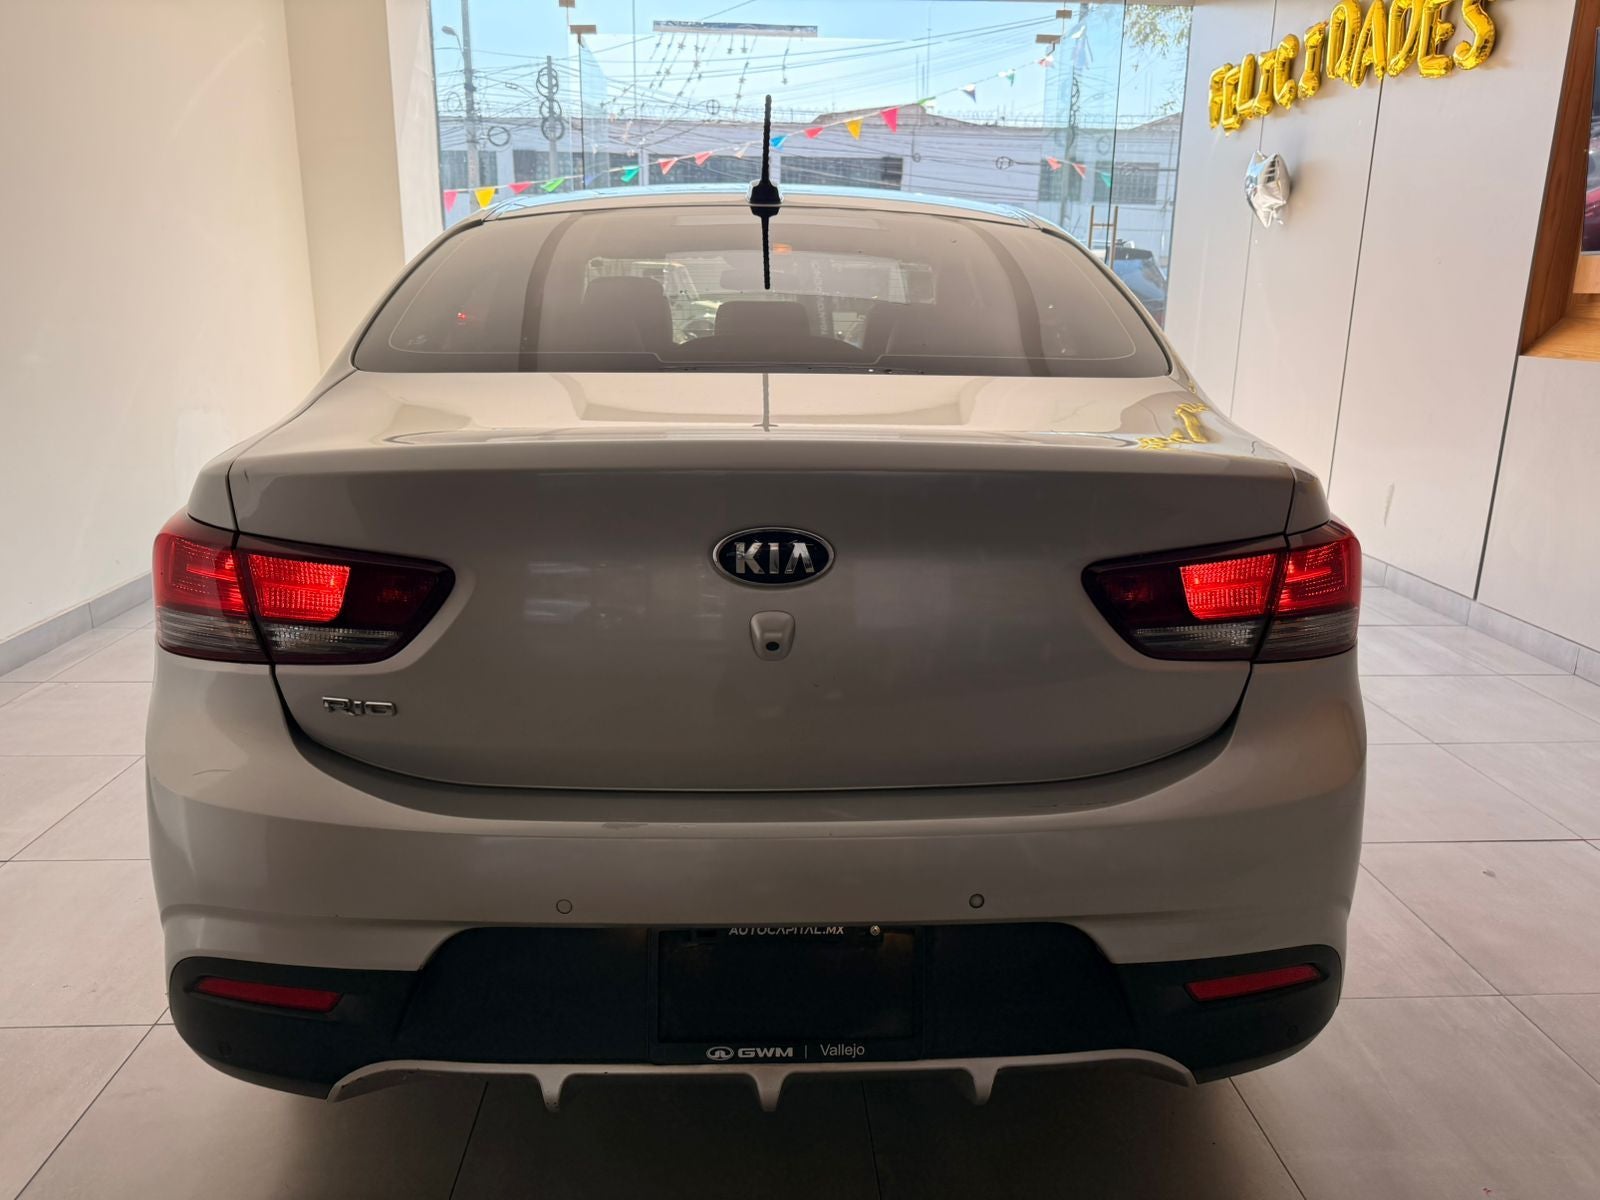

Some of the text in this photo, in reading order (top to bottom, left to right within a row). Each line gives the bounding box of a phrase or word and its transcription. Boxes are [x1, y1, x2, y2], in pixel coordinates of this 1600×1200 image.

[733, 541, 815, 575] KIA
[321, 696, 397, 716] RIO
[738, 1044, 865, 1058] GWM Vallejo
